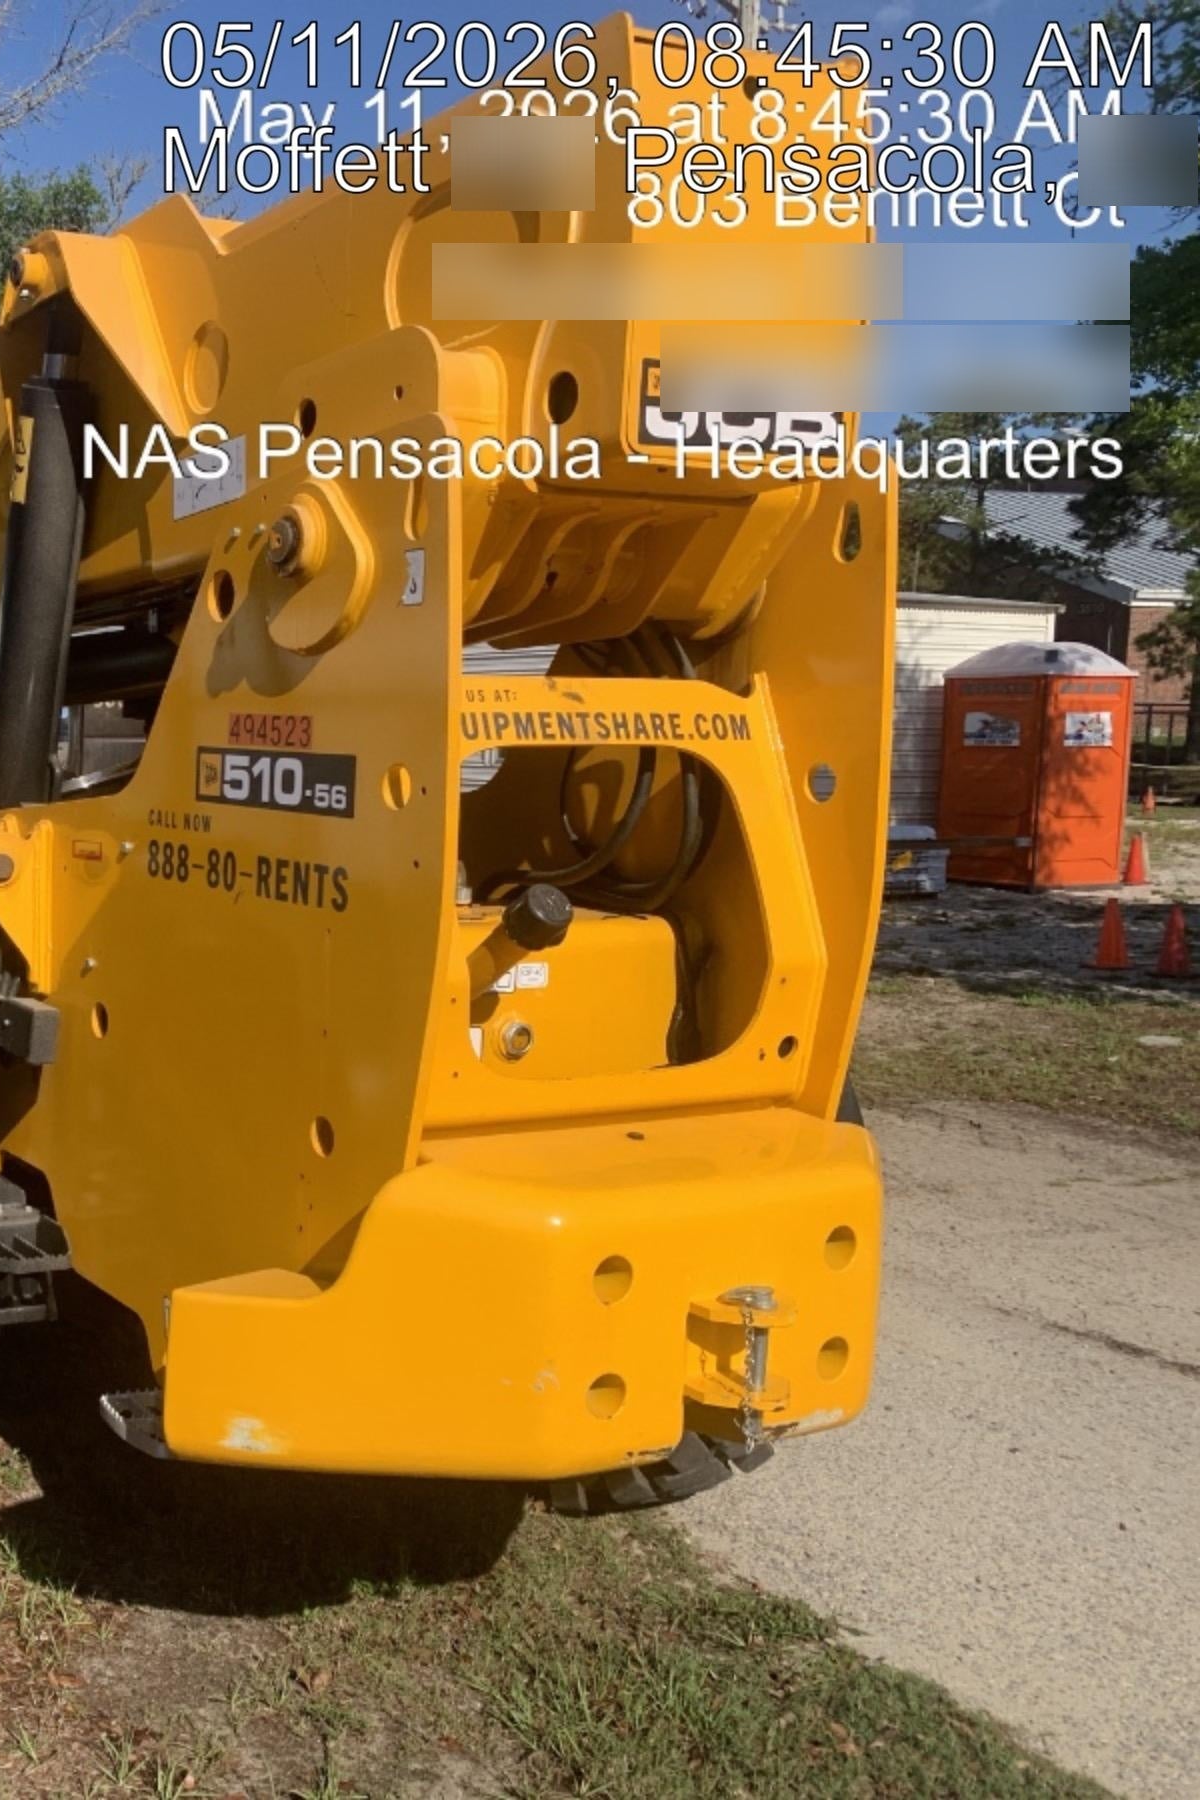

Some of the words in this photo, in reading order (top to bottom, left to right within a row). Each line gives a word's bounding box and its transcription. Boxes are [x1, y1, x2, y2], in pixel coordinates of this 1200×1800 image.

[465, 689, 485, 702] US
[229, 714, 313, 748] 494523
[148, 808, 178, 829] CALL
[183, 813, 212, 833] NOW
[147, 839, 350, 913] 888-80-RENTS
